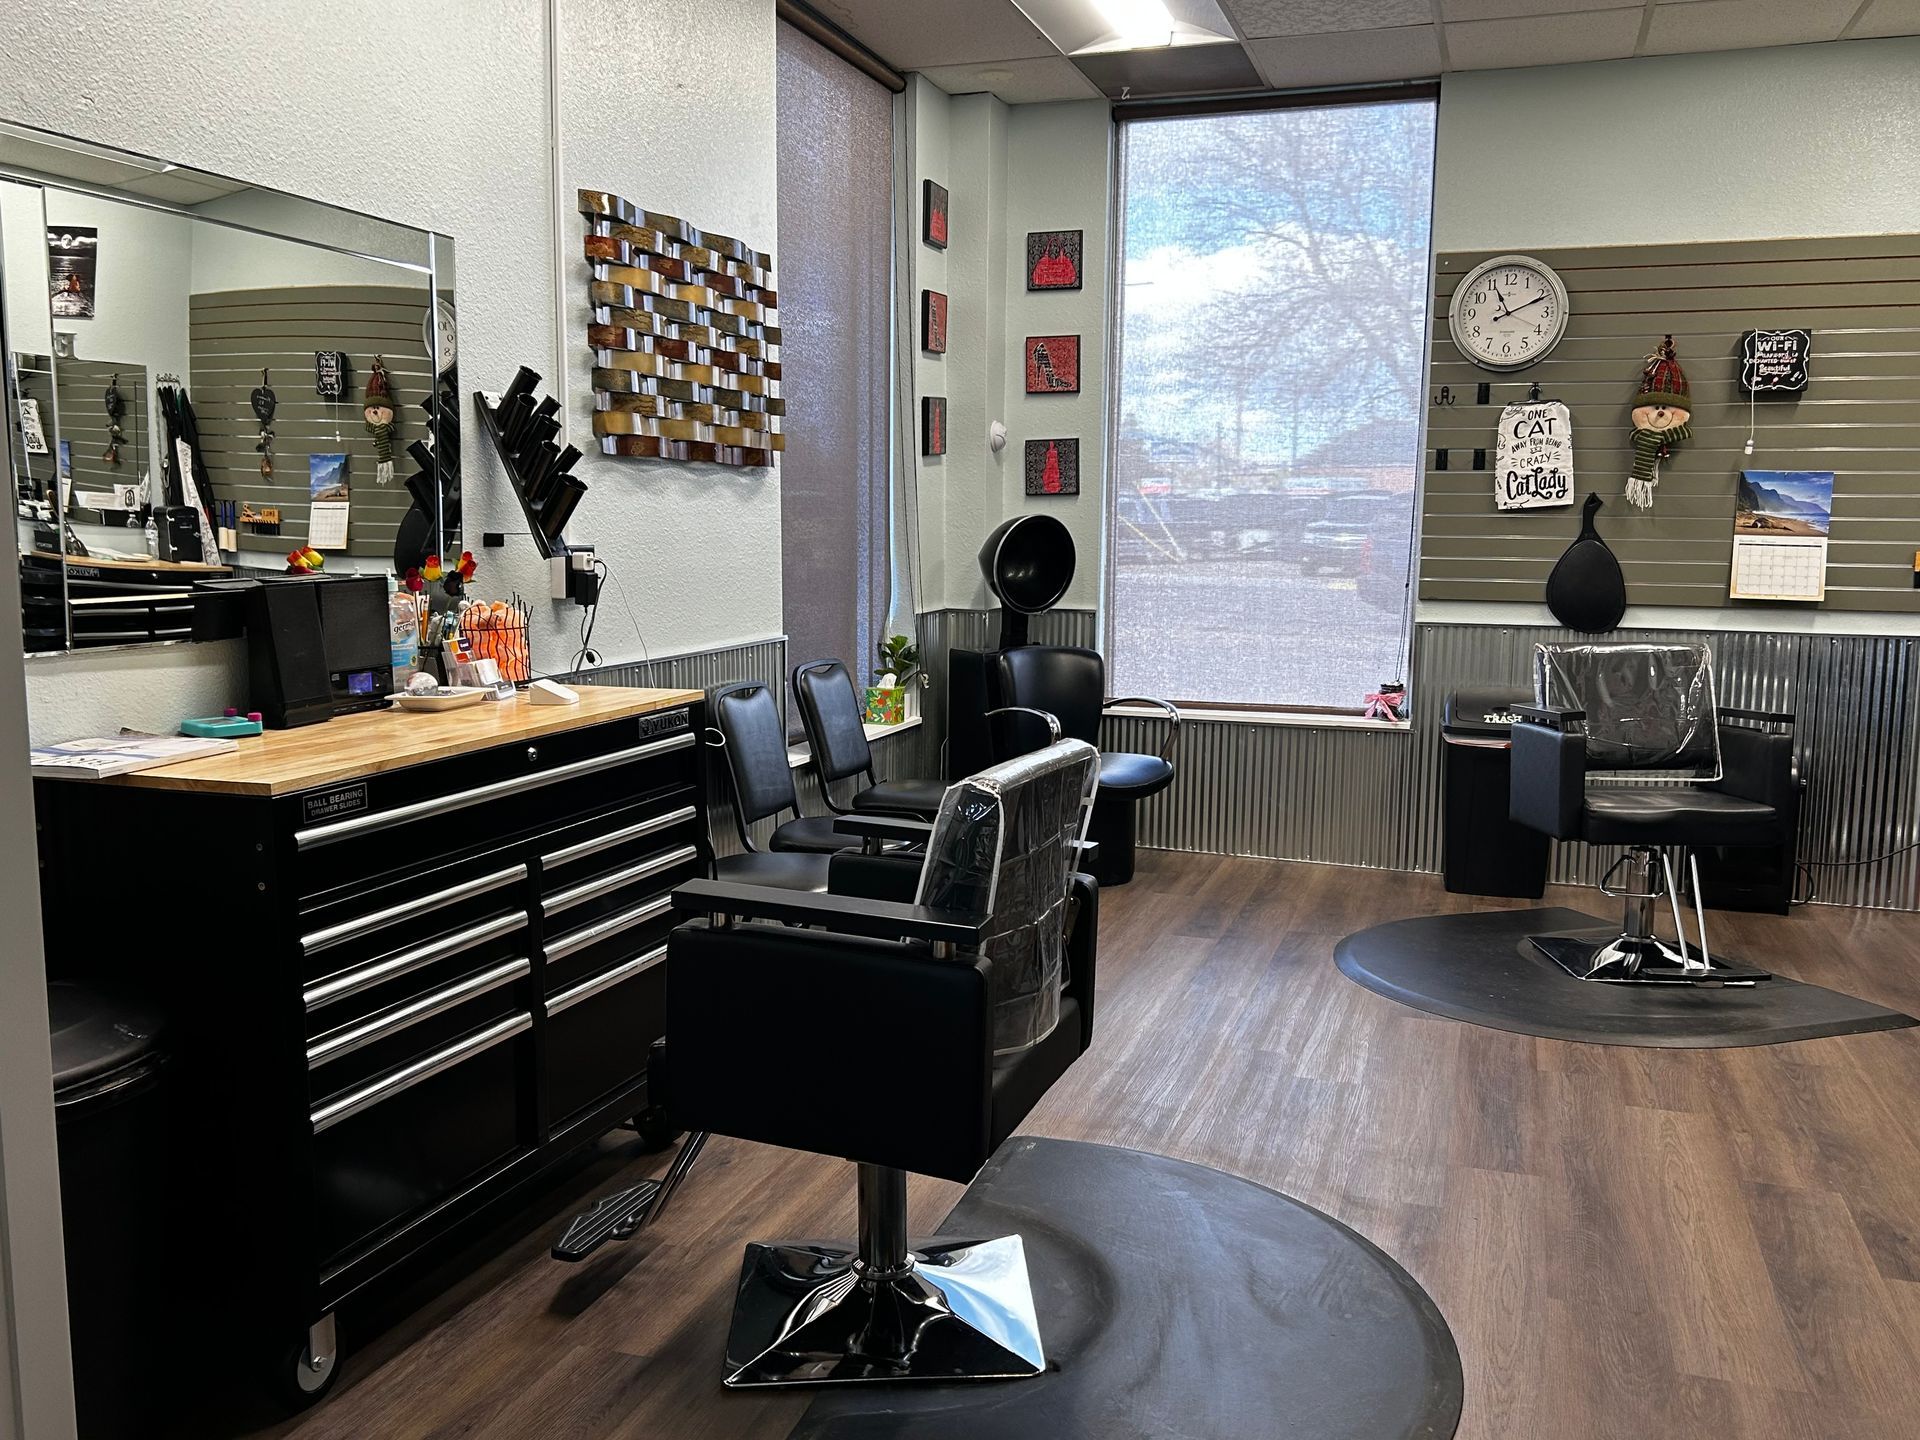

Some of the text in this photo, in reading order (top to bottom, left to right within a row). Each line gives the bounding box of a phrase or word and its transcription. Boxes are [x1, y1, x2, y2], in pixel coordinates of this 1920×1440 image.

[1488, 279, 1497, 291] 11
[1504, 273, 1518, 286] 12
[1525, 277, 1530, 289] 1
[1474, 292, 1487, 304] 10
[1537, 288, 1545, 300] 2
[1468, 308, 1476, 320] 9
[1541, 306, 1549, 319] 3
[1472, 325, 1481, 338] 8
[1534, 323, 1542, 335] 4
[1485, 337, 1493, 349] 7
[1503, 341, 1511, 353] 6
[1520, 336, 1529, 349] 5
[1528, 409, 1548, 421] ONE
[1513, 417, 1557, 439] CAT
[1511, 440, 1527, 454] AWAY
[1519, 451, 1552, 469] CRAZY
[1506, 467, 1568, 500] Cat Lady
[1483, 711, 1522, 724] TRASH
[307, 789, 363, 810] BALL BEARING
[311, 798, 361, 816] DRAWER SLIDES
